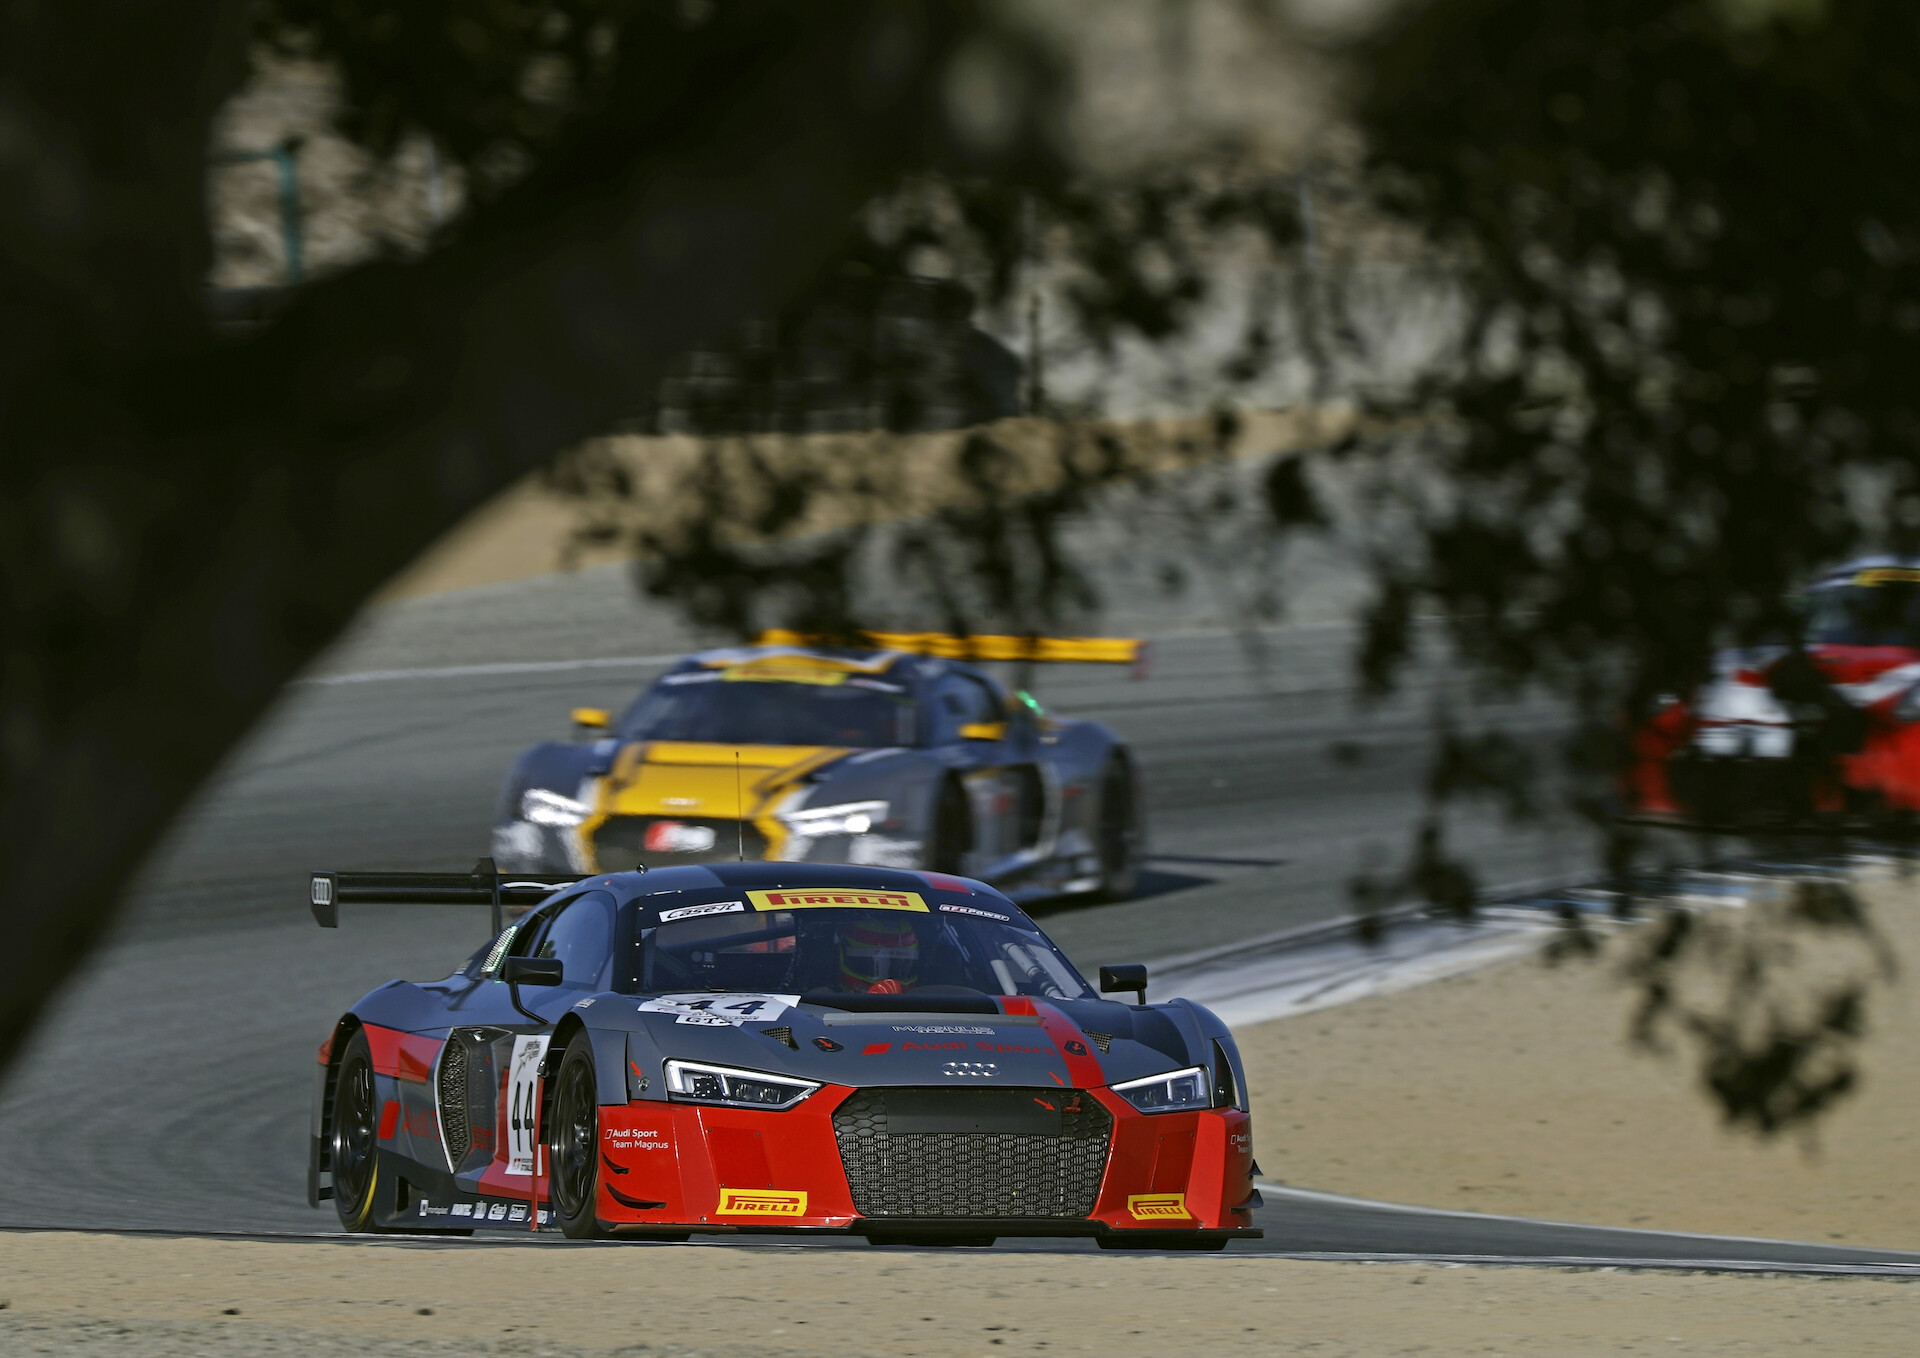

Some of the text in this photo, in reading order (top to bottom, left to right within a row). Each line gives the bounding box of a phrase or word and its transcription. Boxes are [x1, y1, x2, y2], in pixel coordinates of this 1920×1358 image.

[765, 892, 910, 907] PIRELLI
[902, 1042, 1060, 1056] Audi Sport
[511, 1081, 534, 1152] 44
[613, 1129, 658, 1139] Audi Sport
[612, 1140, 669, 1151] Team Magnus
[725, 1195, 800, 1212] PIRELLI
[1133, 1200, 1184, 1215] PIRELLI
